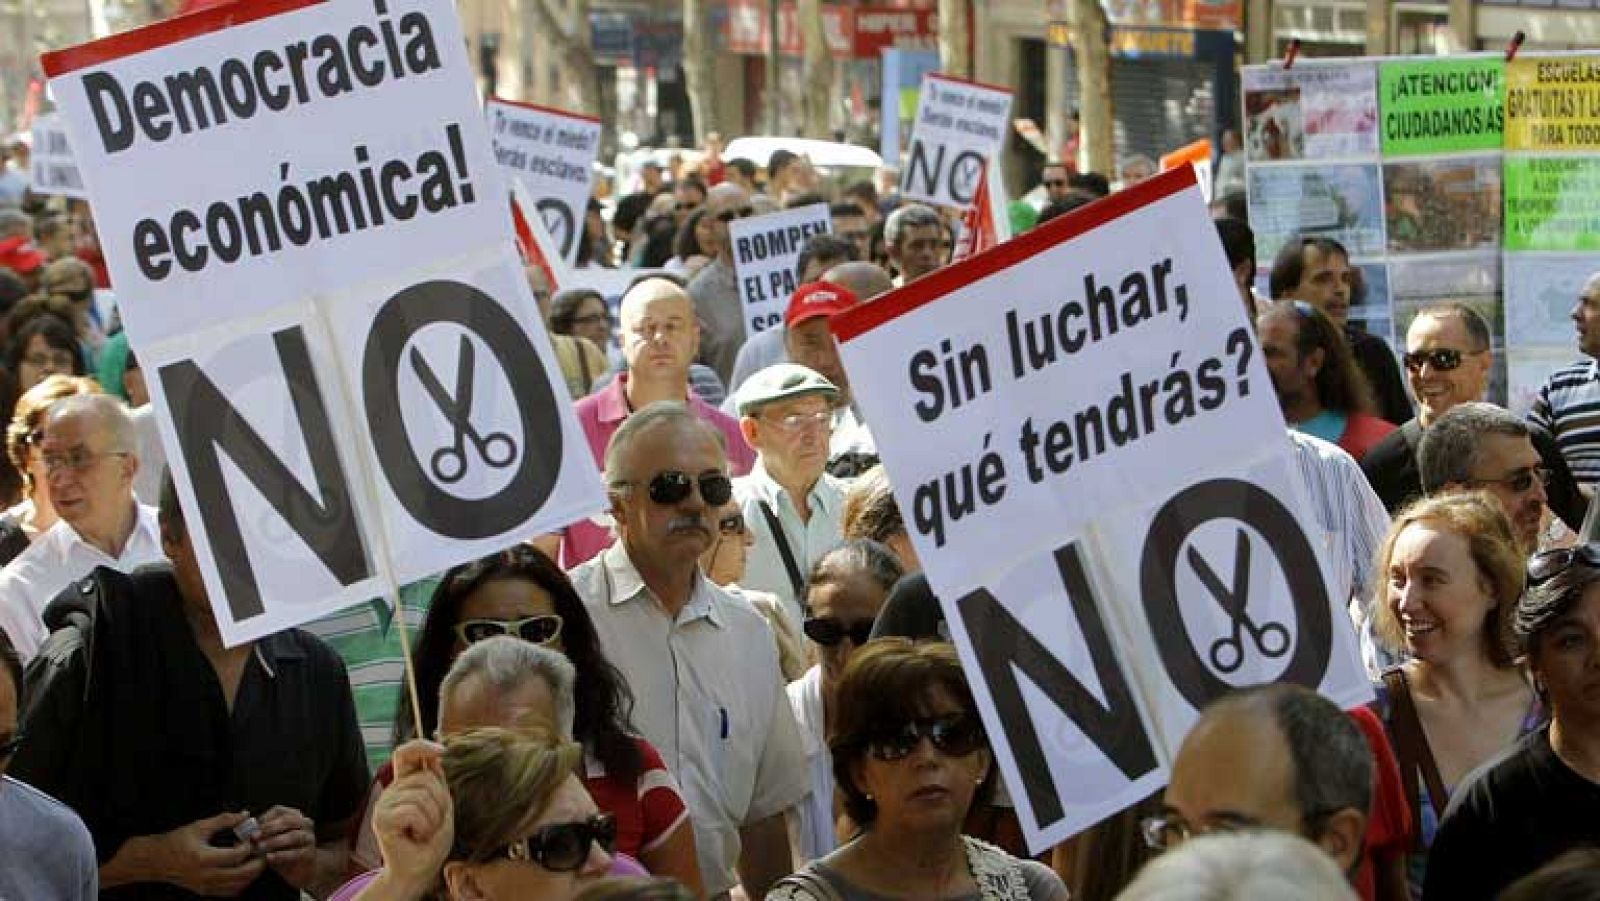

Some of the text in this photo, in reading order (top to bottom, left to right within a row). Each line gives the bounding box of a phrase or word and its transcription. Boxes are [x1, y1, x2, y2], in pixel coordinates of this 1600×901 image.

[82, 0, 440, 153] Democracia
[134, 123, 473, 281] económica!
[904, 140, 987, 204] NO
[745, 275, 767, 303] EL
[909, 258, 1189, 423] Sin luchar,
[159, 281, 562, 621] NO
[913, 328, 1252, 549] qué tendrás?
[956, 478, 1333, 831] NO
